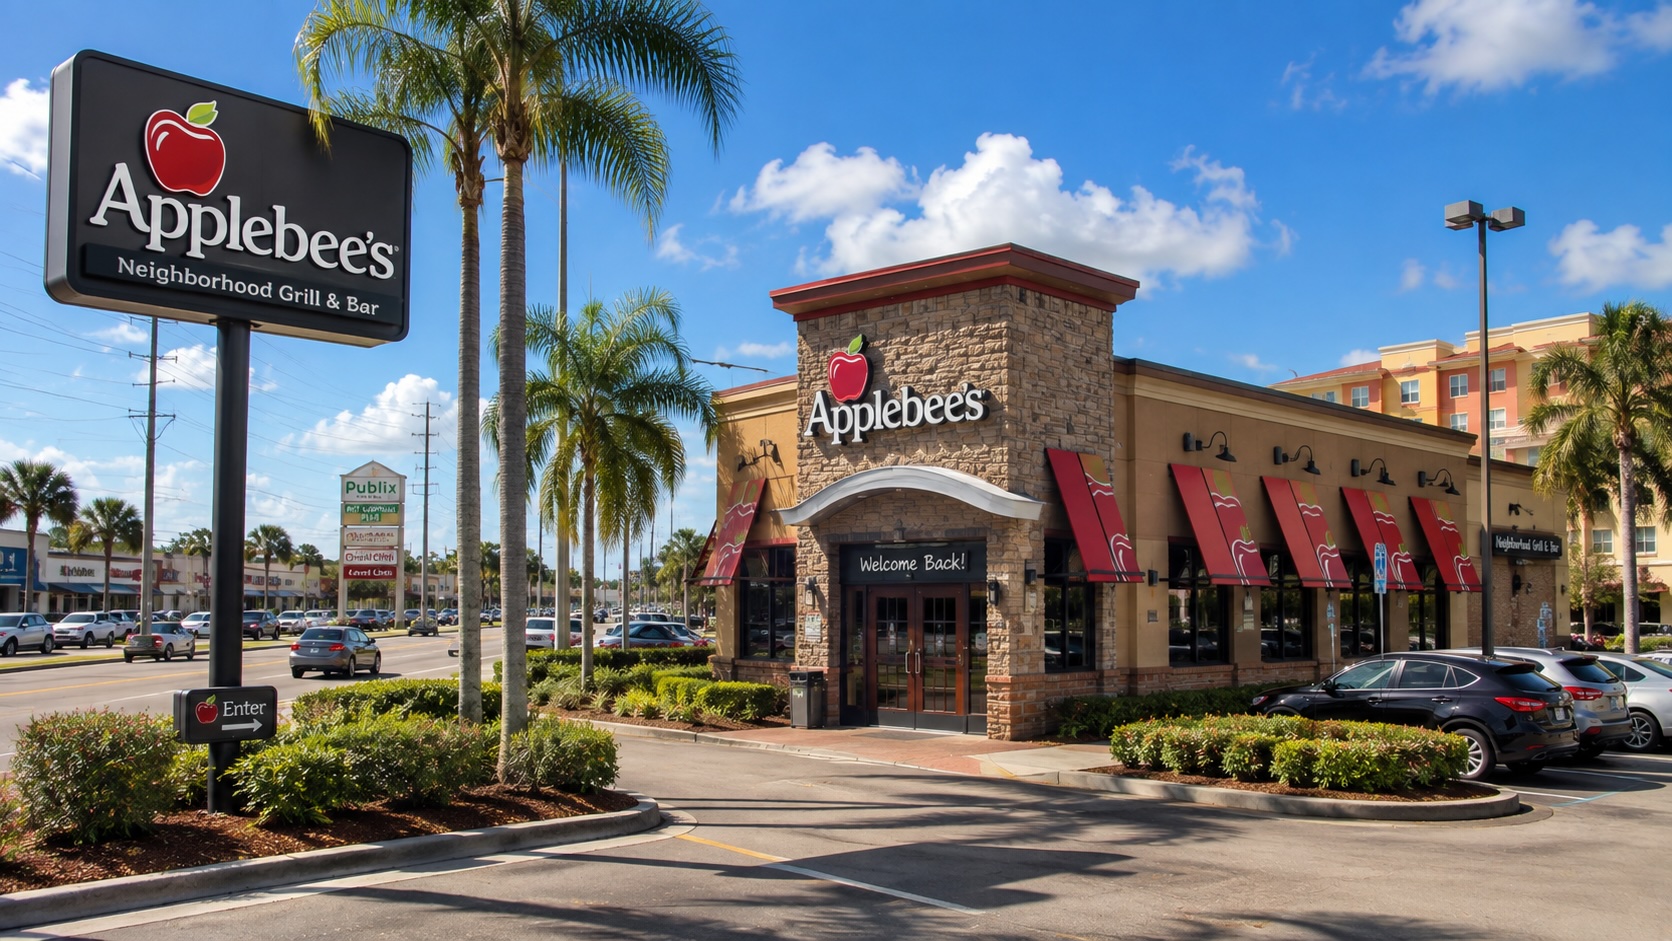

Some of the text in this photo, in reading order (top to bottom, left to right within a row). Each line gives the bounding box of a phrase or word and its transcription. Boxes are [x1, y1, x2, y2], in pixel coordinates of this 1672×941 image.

[117, 256, 380, 316] Neighborhood Grill & Bar
[803, 382, 986, 446] Applebee's
[345, 481, 397, 494] Publix
[860, 552, 965, 572] Welcome Back!
[222, 701, 267, 717] Enter
